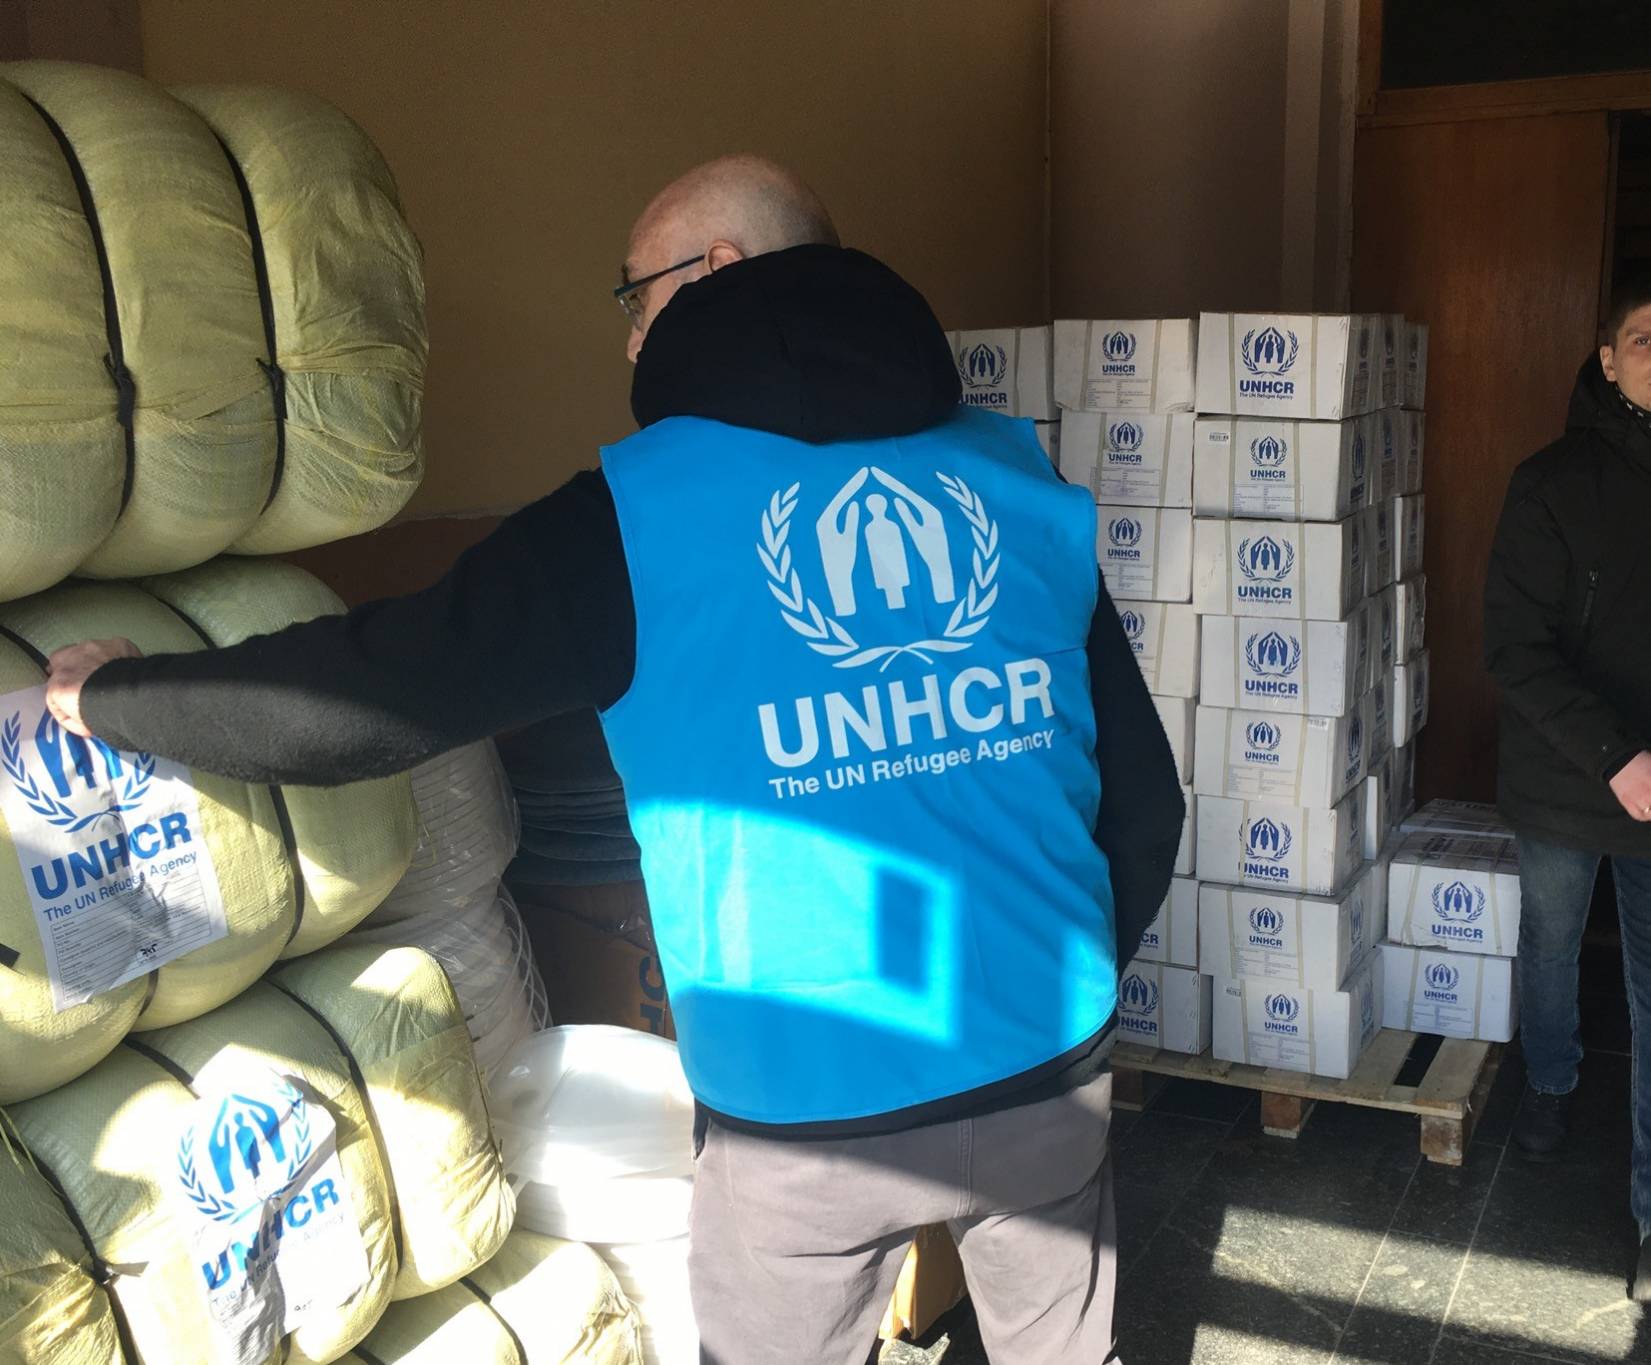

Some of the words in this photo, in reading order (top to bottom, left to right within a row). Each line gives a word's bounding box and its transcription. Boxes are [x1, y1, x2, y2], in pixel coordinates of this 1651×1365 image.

[1102, 365, 1136, 373] UNHCR
[1240, 380, 1294, 394] UNHCR
[1109, 454, 1142, 462] UNHCR
[1250, 470, 1286, 478] UNHCR
[1108, 548, 1140, 557] UNHCR
[1238, 586, 1292, 599] UNHCR
[1245, 680, 1298, 694] UNHCR
[758, 658, 1055, 768] UNHCR
[1245, 752, 1279, 762] UNHCR
[769, 775, 820, 799] The
[825, 764, 866, 790] UN
[872, 746, 971, 782] Refugee
[977, 730, 1056, 760] Agency
[31, 812, 192, 900] UNHCR
[44, 905, 72, 922] The
[75, 892, 96, 910] UN
[100, 872, 145, 900] Refugee
[150, 852, 197, 876] Agency
[1432, 924, 1483, 938] UNHCR
[1249, 936, 1282, 946] UNHCR
[1424, 990, 1457, 1000] UNHCR
[1118, 1016, 1157, 1032] NHCR
[1265, 1022, 1298, 1032] UNHCR
